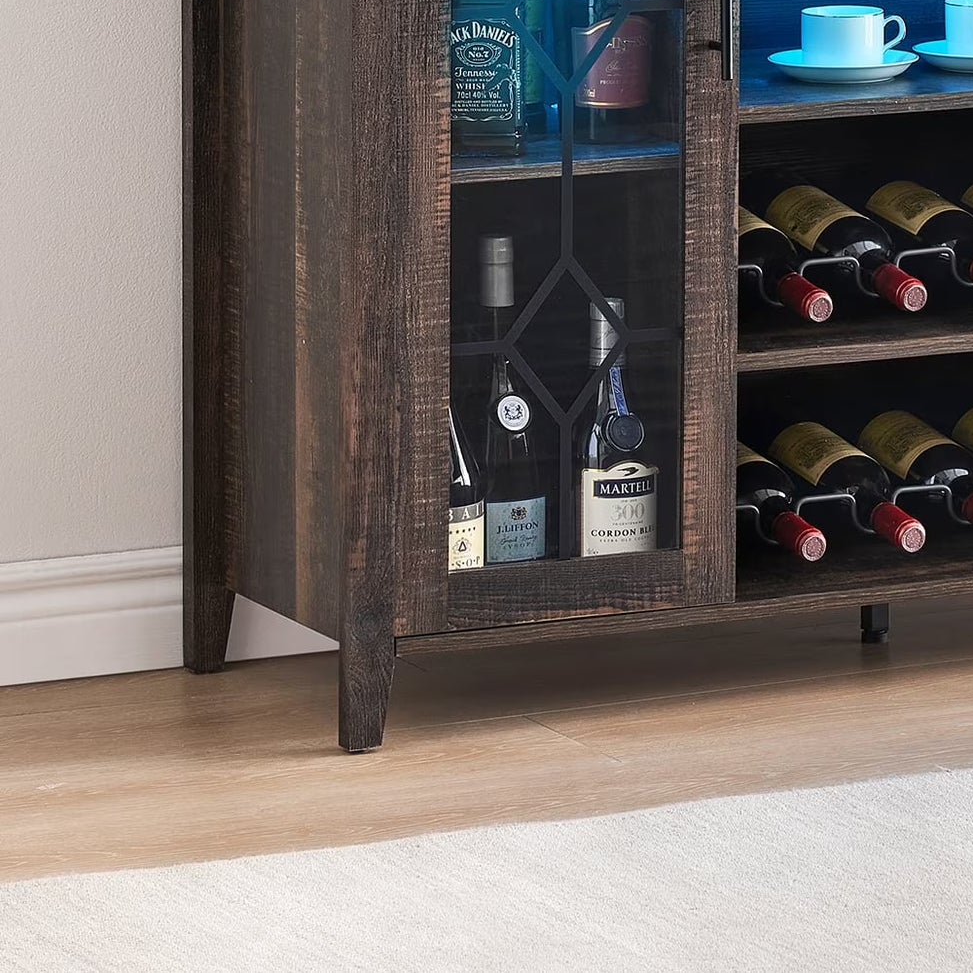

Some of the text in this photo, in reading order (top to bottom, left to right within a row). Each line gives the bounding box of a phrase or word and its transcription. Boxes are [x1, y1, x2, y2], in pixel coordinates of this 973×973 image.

[450, 21, 517, 48] ACK DANIEL'S
[600, 480, 651, 494] MARTELL
[496, 521, 539, 534] J.LIFFON
[590, 528, 637, 537] CORDON
